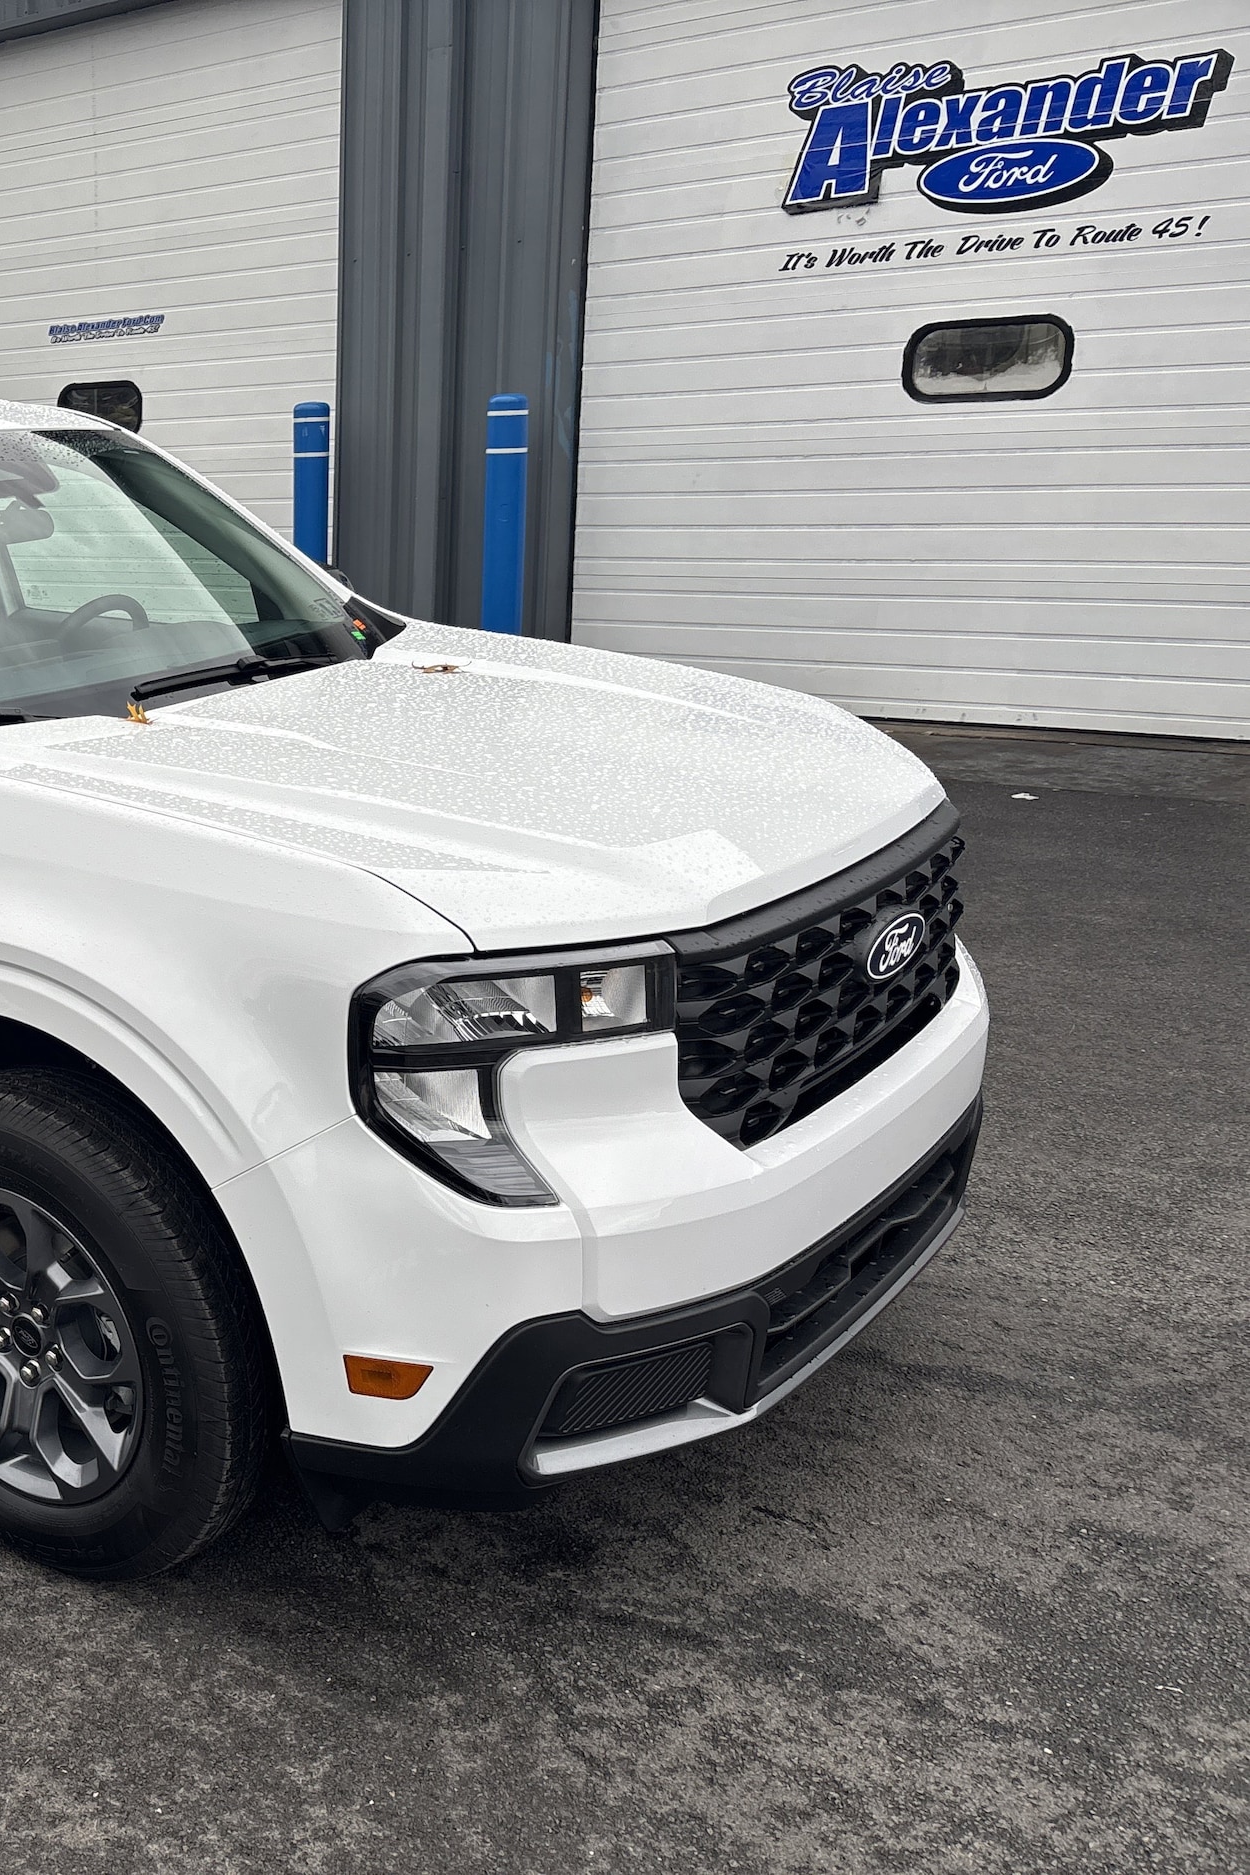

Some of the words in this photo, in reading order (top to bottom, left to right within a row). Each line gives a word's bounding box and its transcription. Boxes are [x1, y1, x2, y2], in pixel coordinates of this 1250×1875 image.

[790, 59, 953, 112] Blaise
[784, 52, 1222, 207] Alexander
[957, 151, 1056, 194] Ford
[778, 251, 818, 272] It's
[824, 242, 897, 268] Worth
[904, 238, 945, 261] The
[955, 234, 1025, 257] Drive
[1032, 228, 1061, 249] To
[1069, 222, 1143, 246] Route
[878, 922, 917, 973] Ford
[146, 1316, 185, 1478] Continental
